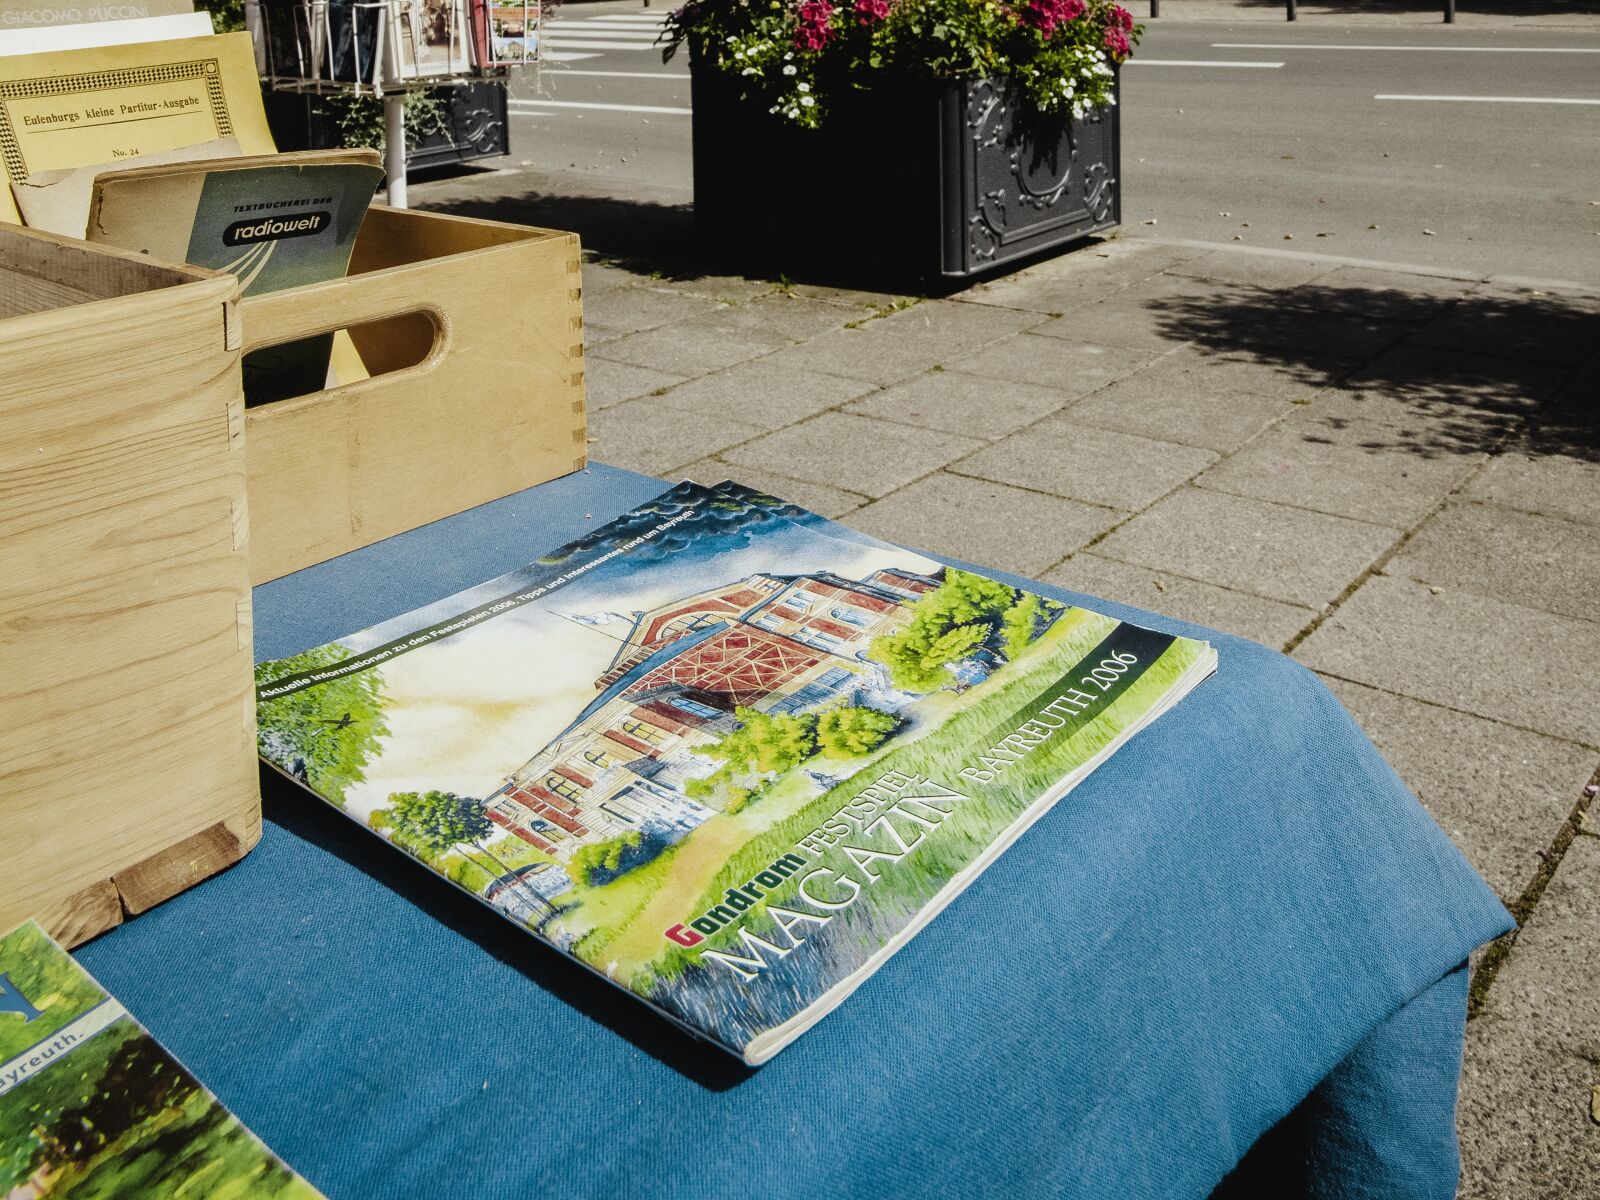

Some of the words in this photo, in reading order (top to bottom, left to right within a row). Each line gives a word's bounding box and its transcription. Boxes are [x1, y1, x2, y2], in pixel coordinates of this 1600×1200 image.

[2, 8, 82, 25] GIACOMO
[87, 4, 149, 22] PUCCINI
[23, 111, 80, 126] Eulenburgs
[85, 104, 115, 119] kleine
[120, 96, 200, 114] Partitur-Ausgabe
[112, 149, 127, 157] No.
[130, 148, 140, 156] 24
[312, 197, 333, 205] DER
[234, 215, 321, 240] radiowelt
[259, 677, 312, 699] Aktuelle
[312, 650, 393, 682] Informationen
[392, 643, 408, 653] zu
[409, 633, 431, 647] den
[431, 610, 491, 638] Festspielen
[516, 586, 548, 602] Tipps
[546, 577, 567, 589] und
[564, 548, 624, 579] Interessantes
[623, 536, 645, 551] rund
[643, 528, 659, 540] um
[656, 509, 696, 532] Bayreuth
[701, 777, 971, 983] MAGAZIN
[957, 687, 1099, 785] BAYREUTH
[1081, 649, 1138, 692] 2006
[664, 852, 809, 948] Gondrom
[795, 768, 921, 857] FESTSPIEL
